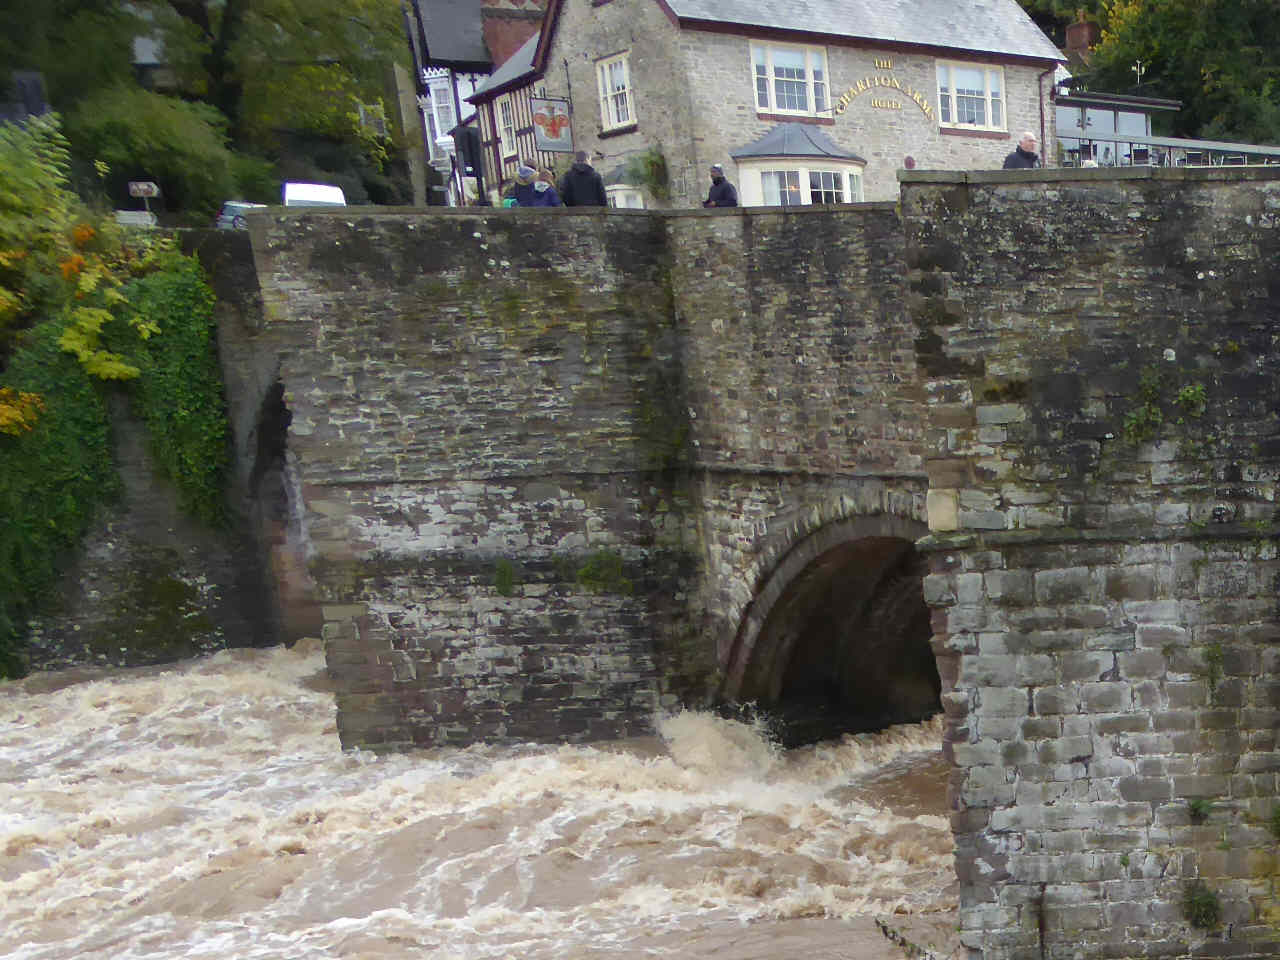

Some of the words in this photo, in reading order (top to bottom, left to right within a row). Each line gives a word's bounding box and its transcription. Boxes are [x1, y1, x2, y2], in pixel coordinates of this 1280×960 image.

[874, 56, 893, 69] THE
[835, 75, 900, 114] CHARLTON
[871, 98, 902, 110] HOTEL
